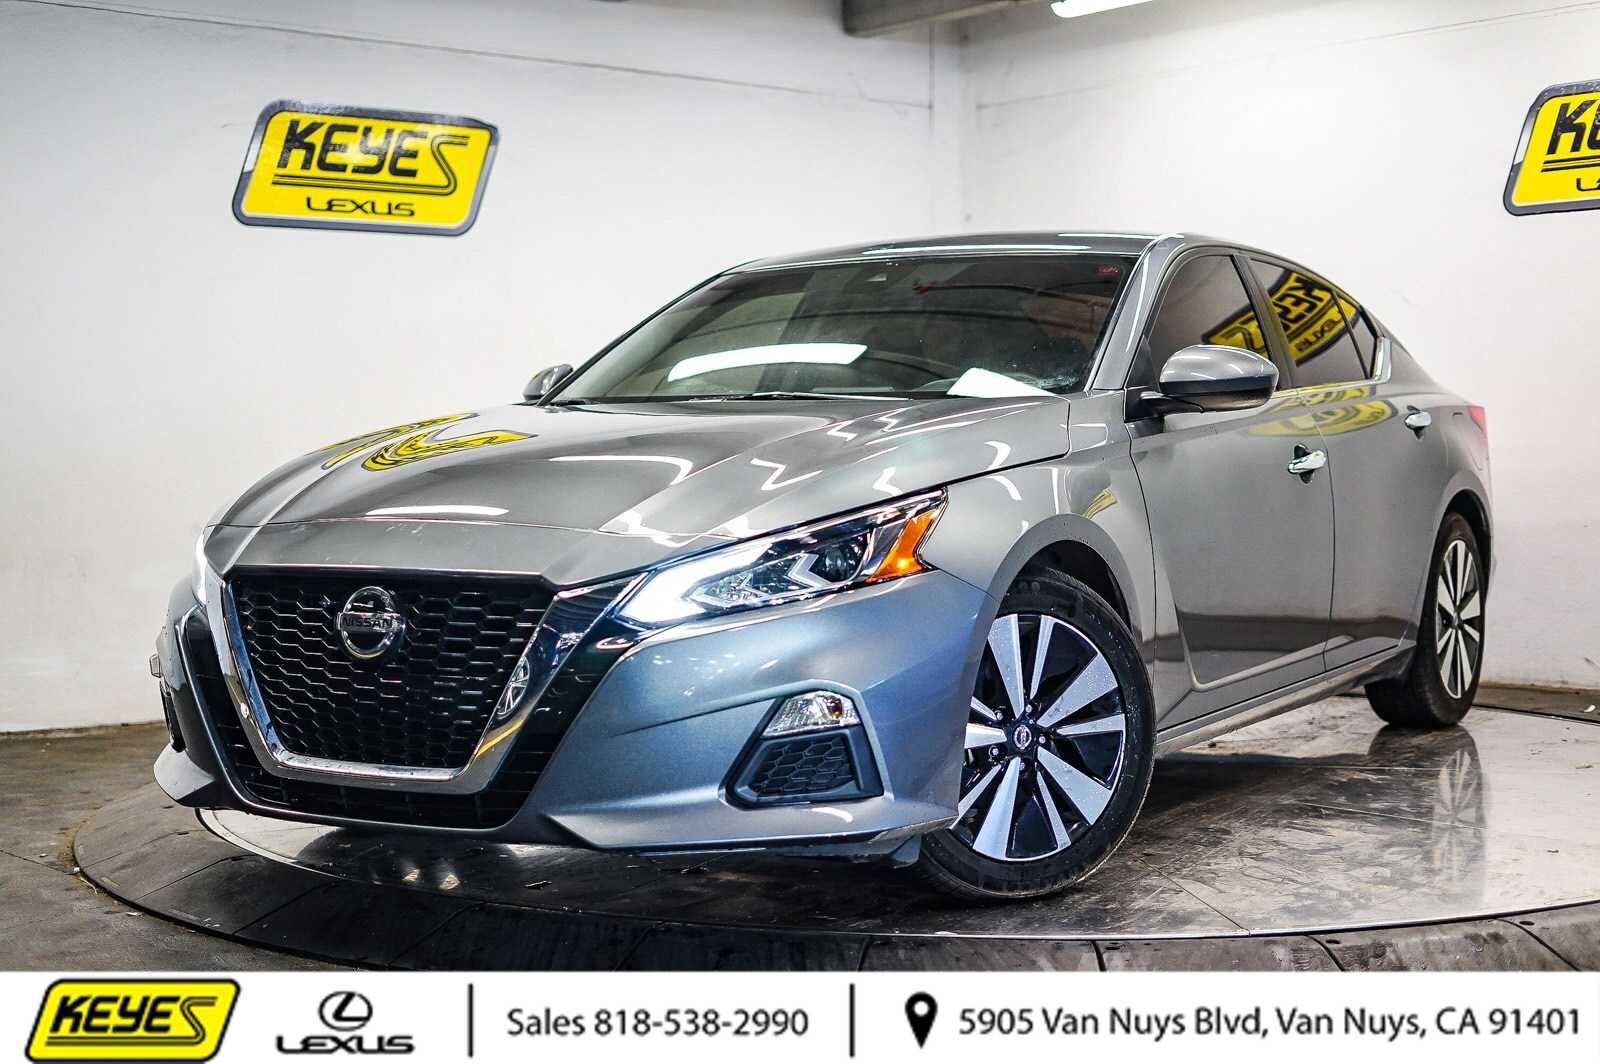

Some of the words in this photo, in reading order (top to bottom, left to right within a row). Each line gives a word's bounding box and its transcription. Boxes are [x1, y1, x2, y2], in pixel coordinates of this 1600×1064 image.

[274, 118, 470, 196] KEYES
[305, 196, 416, 218] LEXUS
[343, 617, 392, 628] NISSAN
